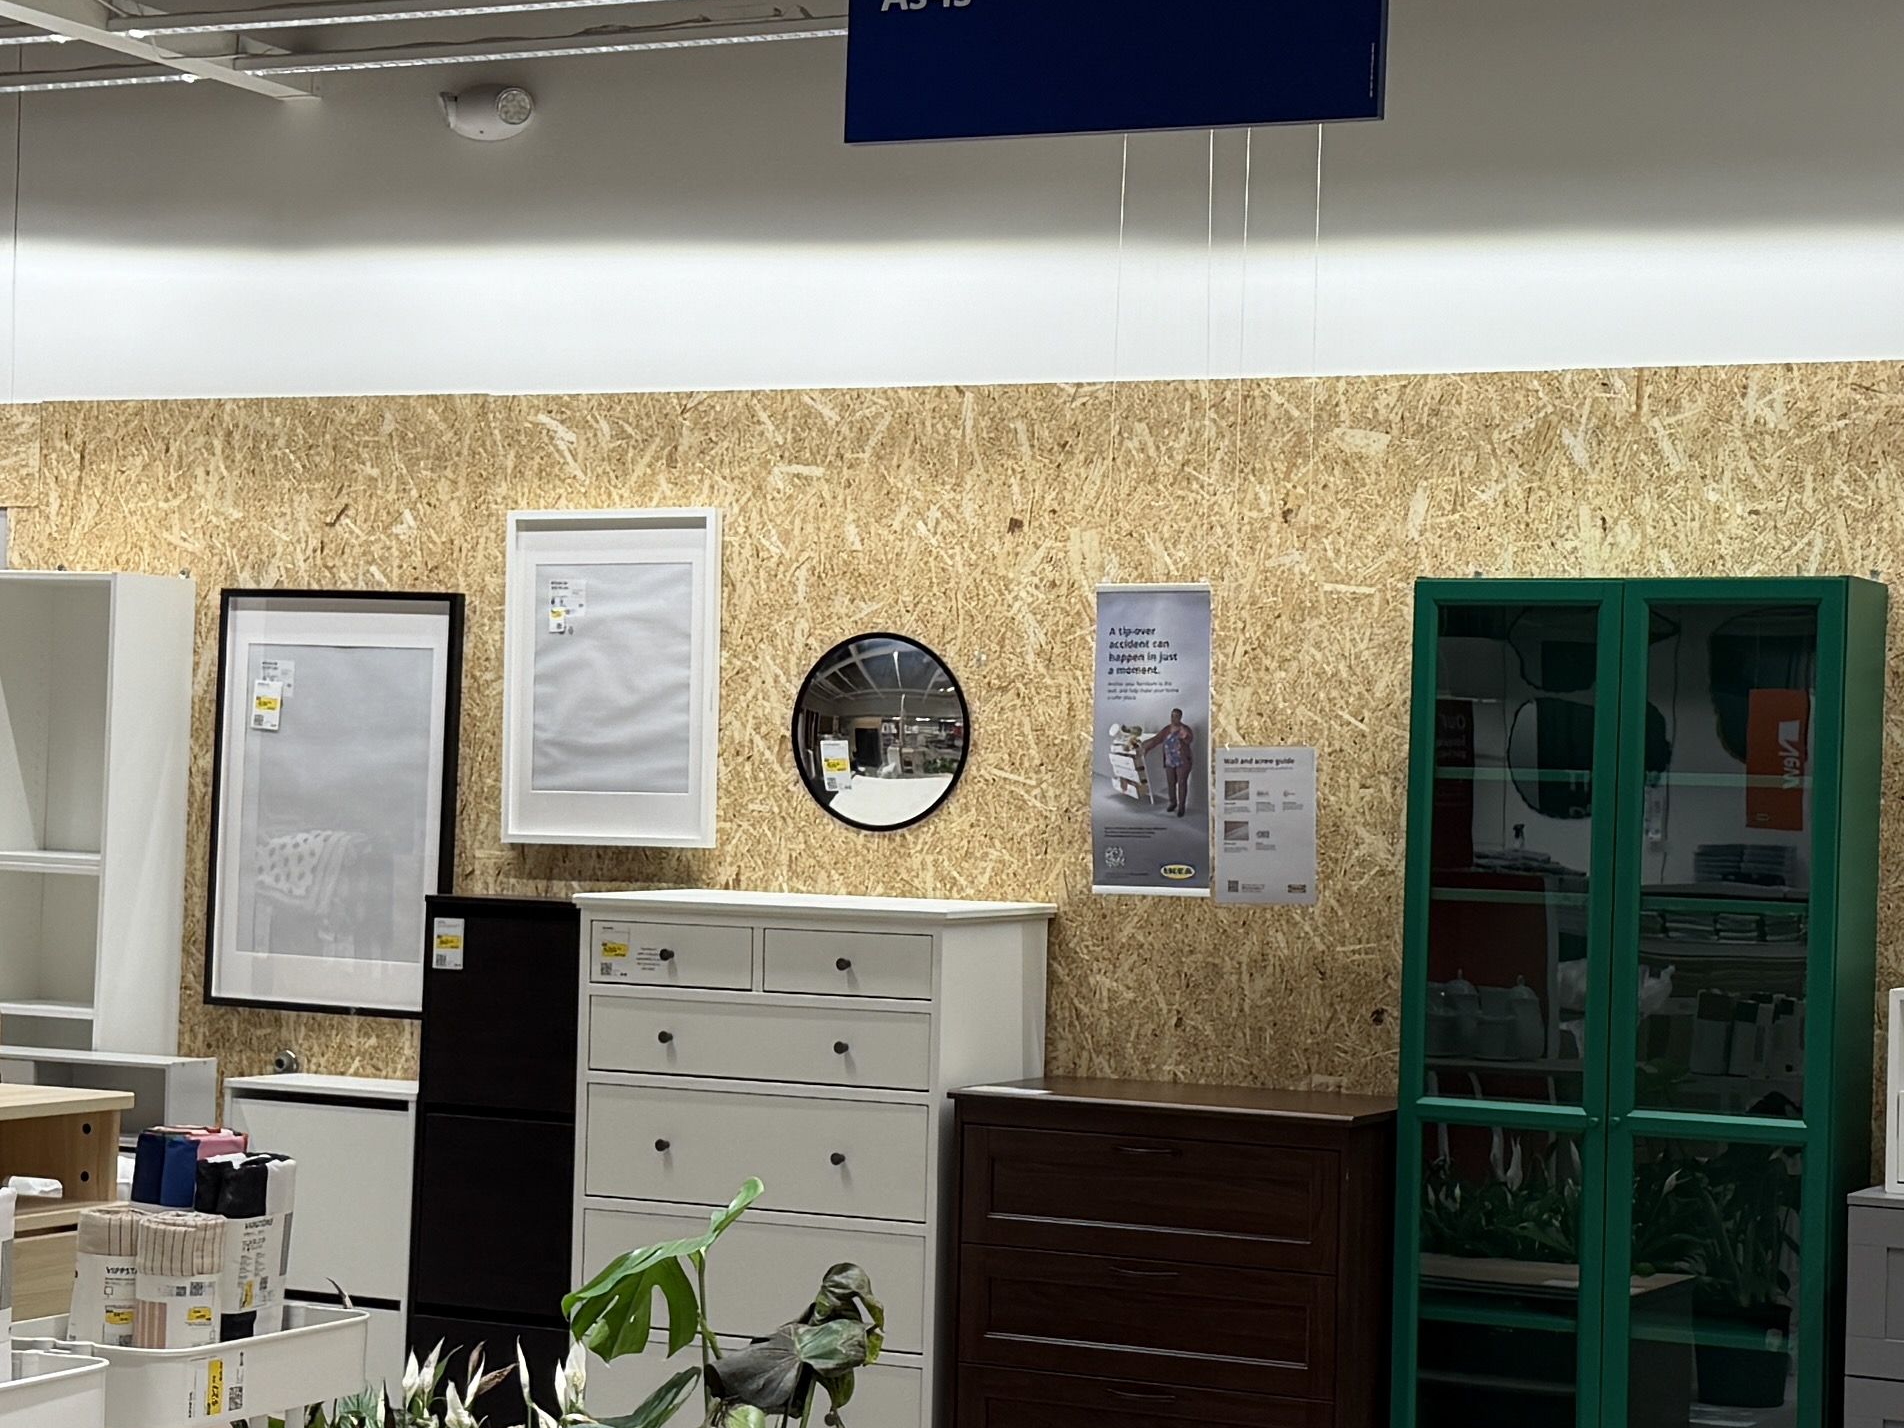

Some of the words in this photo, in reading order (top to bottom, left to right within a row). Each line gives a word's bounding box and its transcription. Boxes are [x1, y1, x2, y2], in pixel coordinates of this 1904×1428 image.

[1109, 640, 1149, 649] accident
[1152, 640, 1170, 649] can
[1109, 652, 1145, 663] happen
[1147, 652, 1157, 661] in
[1159, 652, 1178, 663] just
[1107, 666, 1114, 675] a
